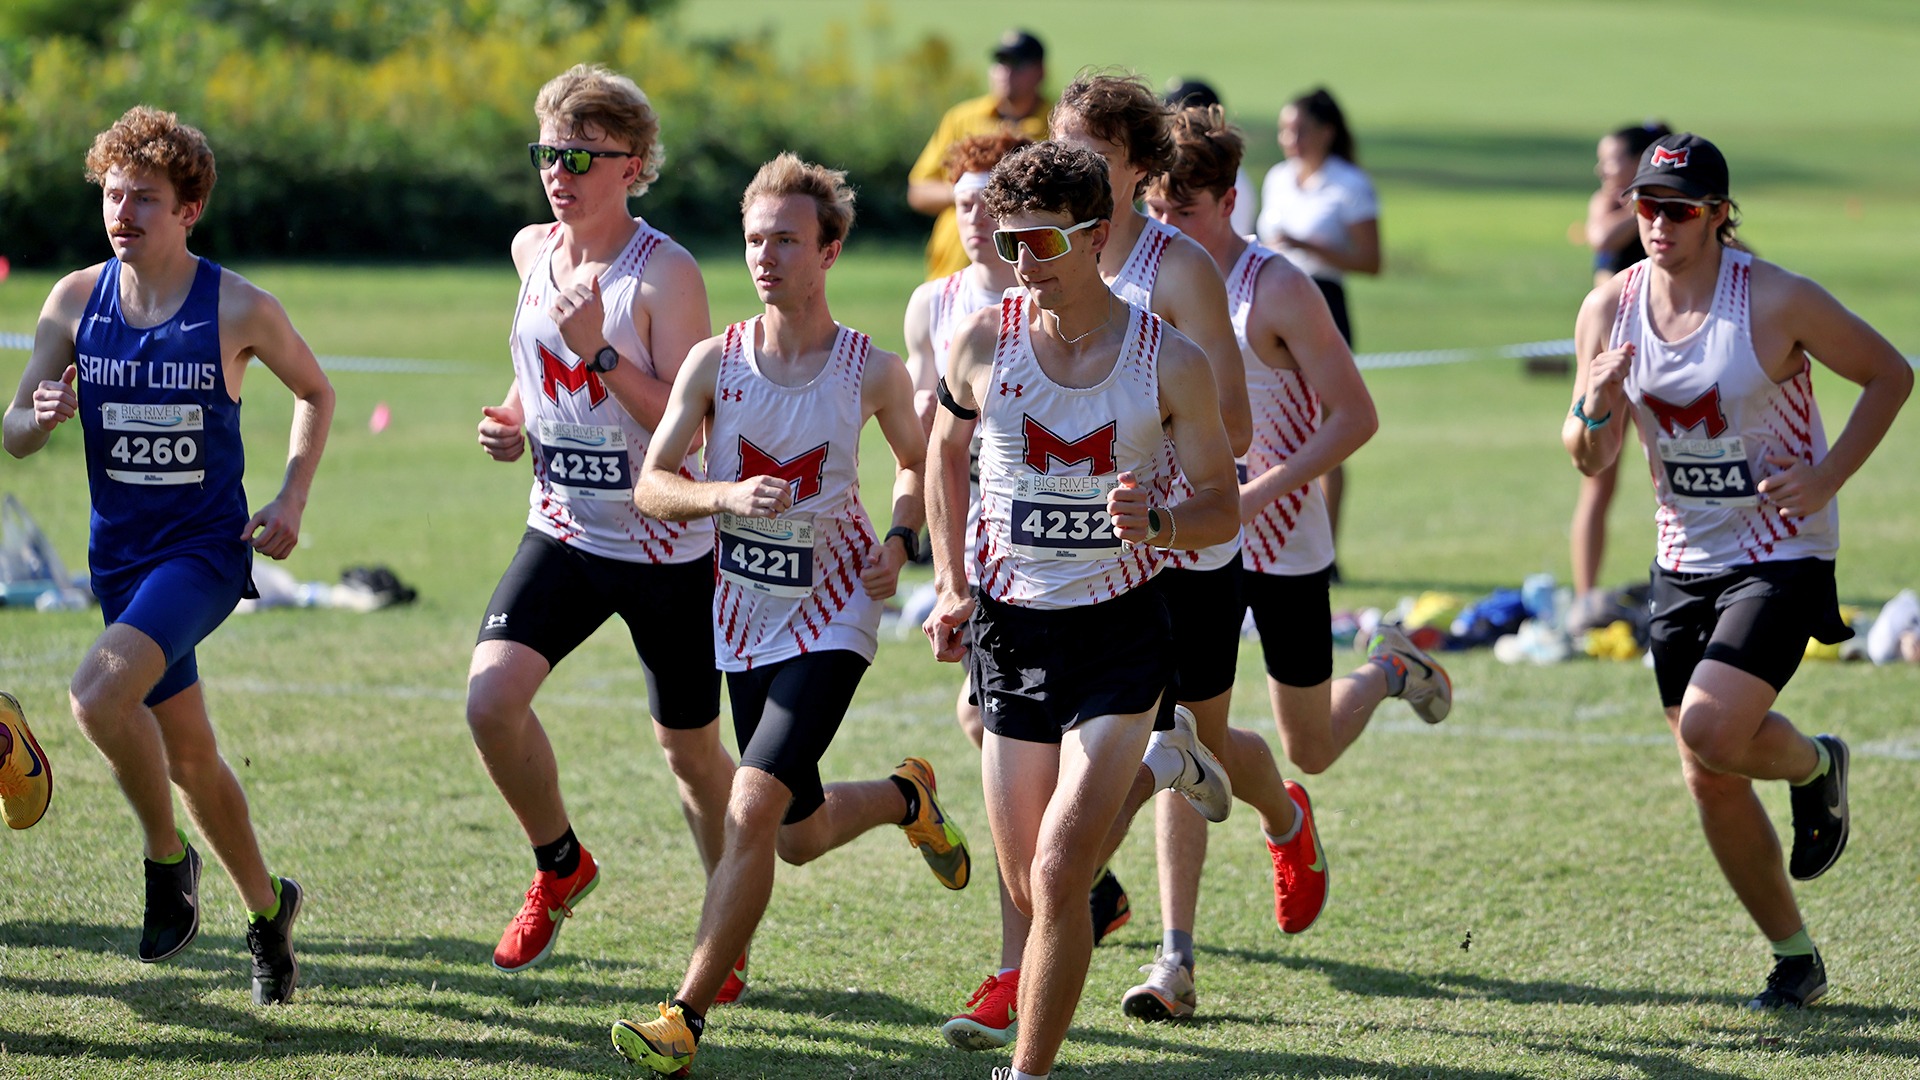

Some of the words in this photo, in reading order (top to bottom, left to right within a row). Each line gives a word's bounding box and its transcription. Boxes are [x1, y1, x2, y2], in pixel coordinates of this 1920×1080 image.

[1650, 145, 1690, 168] M
[79, 353, 141, 387] SAINT
[148, 361, 216, 390] LOUIS
[536, 339, 609, 411] M
[121, 405, 141, 416] BIG
[144, 405, 181, 416] RIVER
[1640, 382, 1728, 440] M
[553, 423, 570, 434] BIG
[572, 424, 604, 436] RIVER
[1022, 412, 1117, 475] M
[110, 436, 197, 465] 4260
[550, 452, 622, 483] 4233
[735, 434, 829, 505] M
[1034, 475, 1056, 489] BIG
[1060, 476, 1099, 489] RIVER
[1673, 466, 1746, 491] 4234
[756, 517, 793, 531] RIVER
[1021, 510, 1112, 540] 4232
[731, 543, 799, 579] 4221
